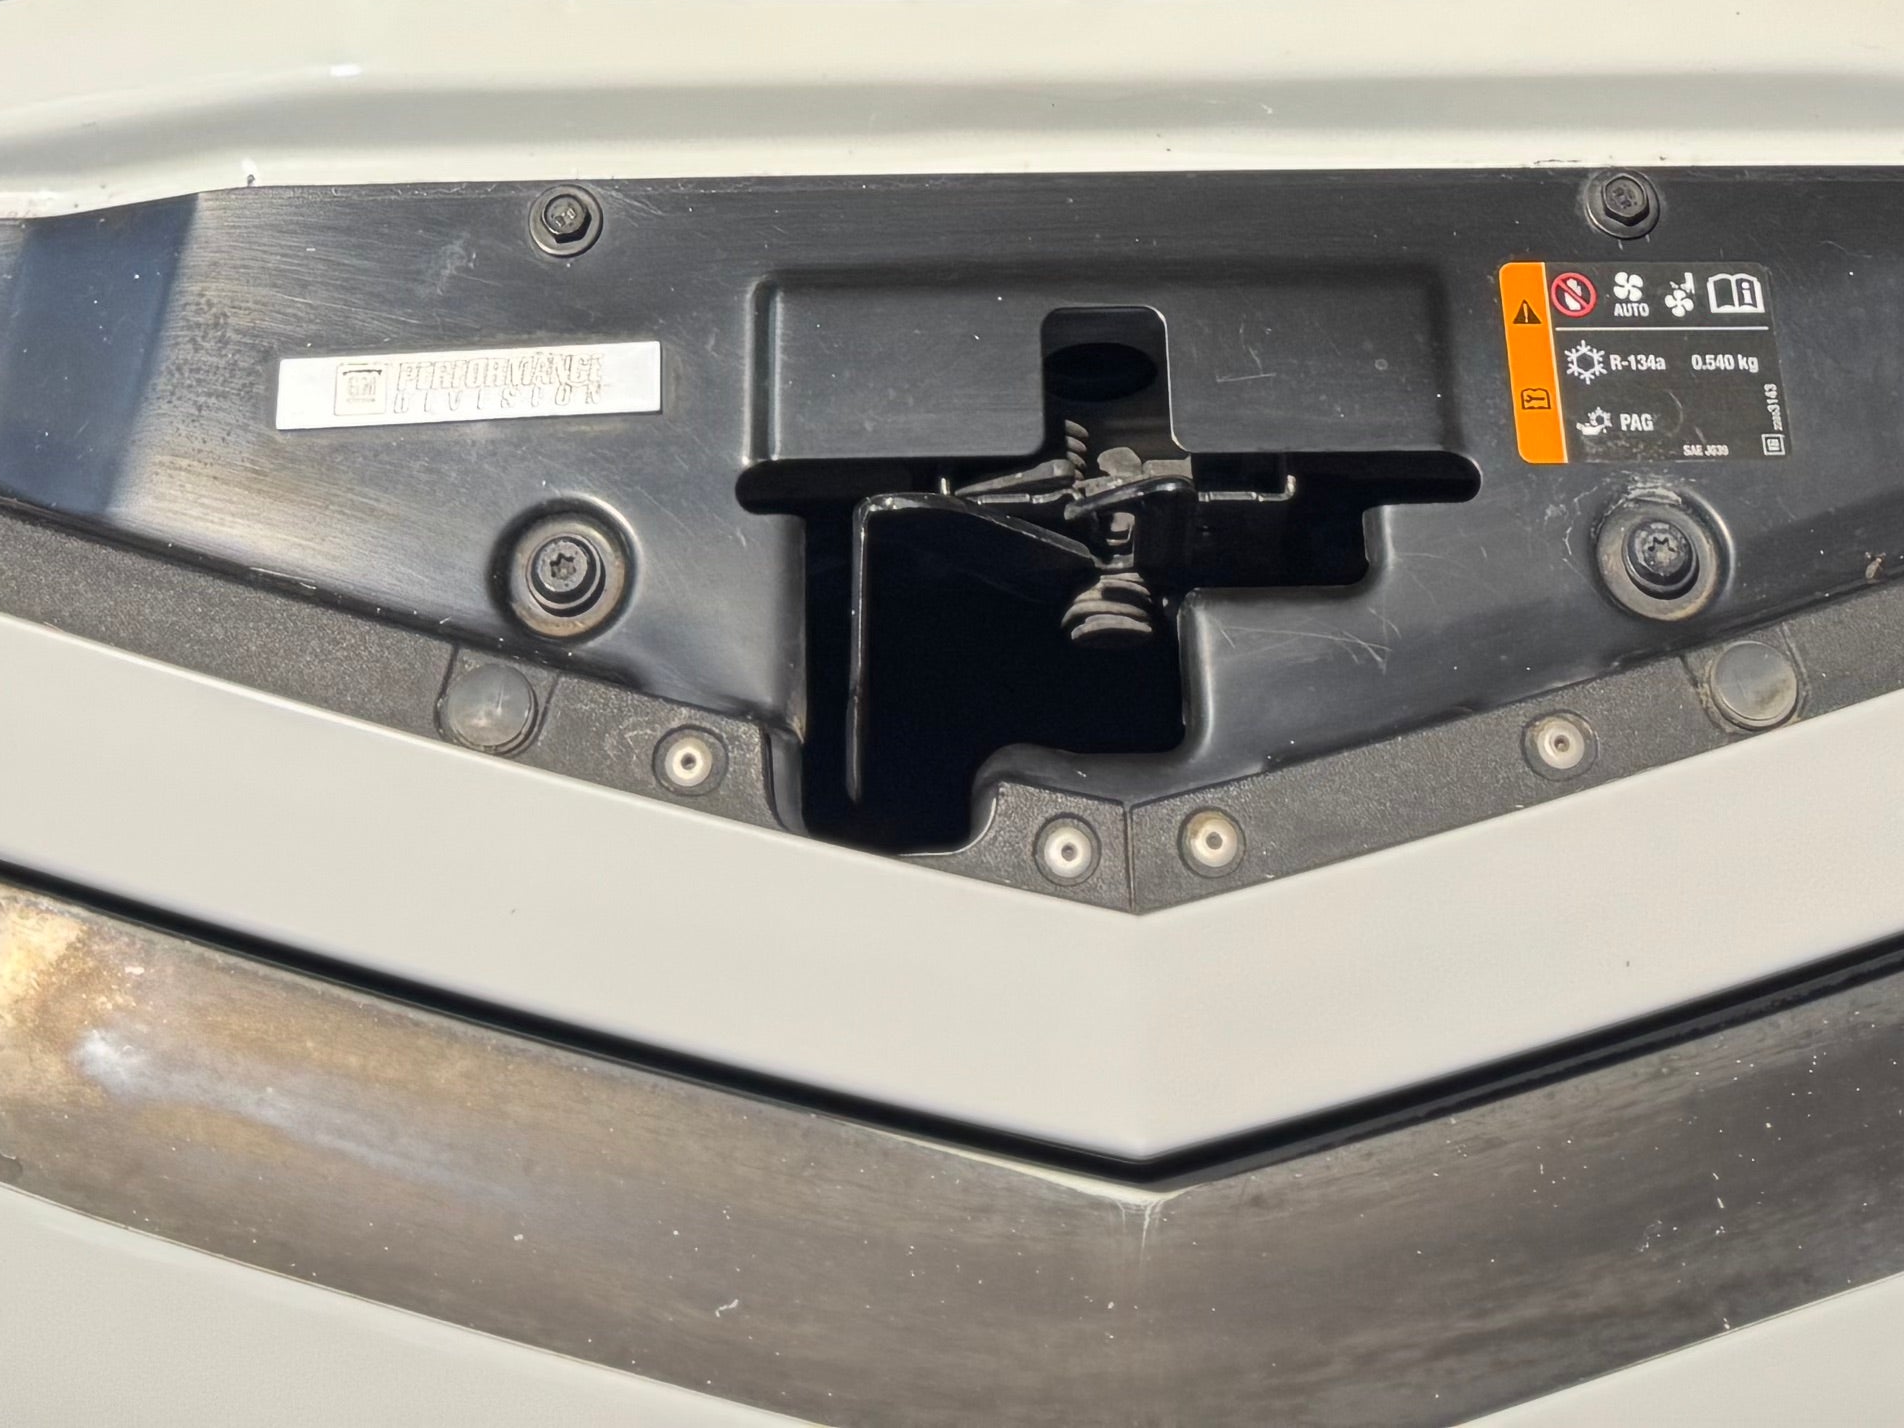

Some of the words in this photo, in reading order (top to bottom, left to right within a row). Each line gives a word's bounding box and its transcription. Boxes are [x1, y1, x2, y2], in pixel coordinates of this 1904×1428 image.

[1613, 302, 1650, 318] AUTO
[396, 353, 605, 391] PERFORMANCE
[1610, 354, 1666, 371] R-134a
[1691, 354, 1735, 371] 0.540
[1737, 354, 1760, 374] kg
[394, 383, 603, 414] DIVISION
[1620, 413, 1654, 432] PAG
[1683, 444, 1704, 458] SAE
[1705, 444, 1729, 458] J639
